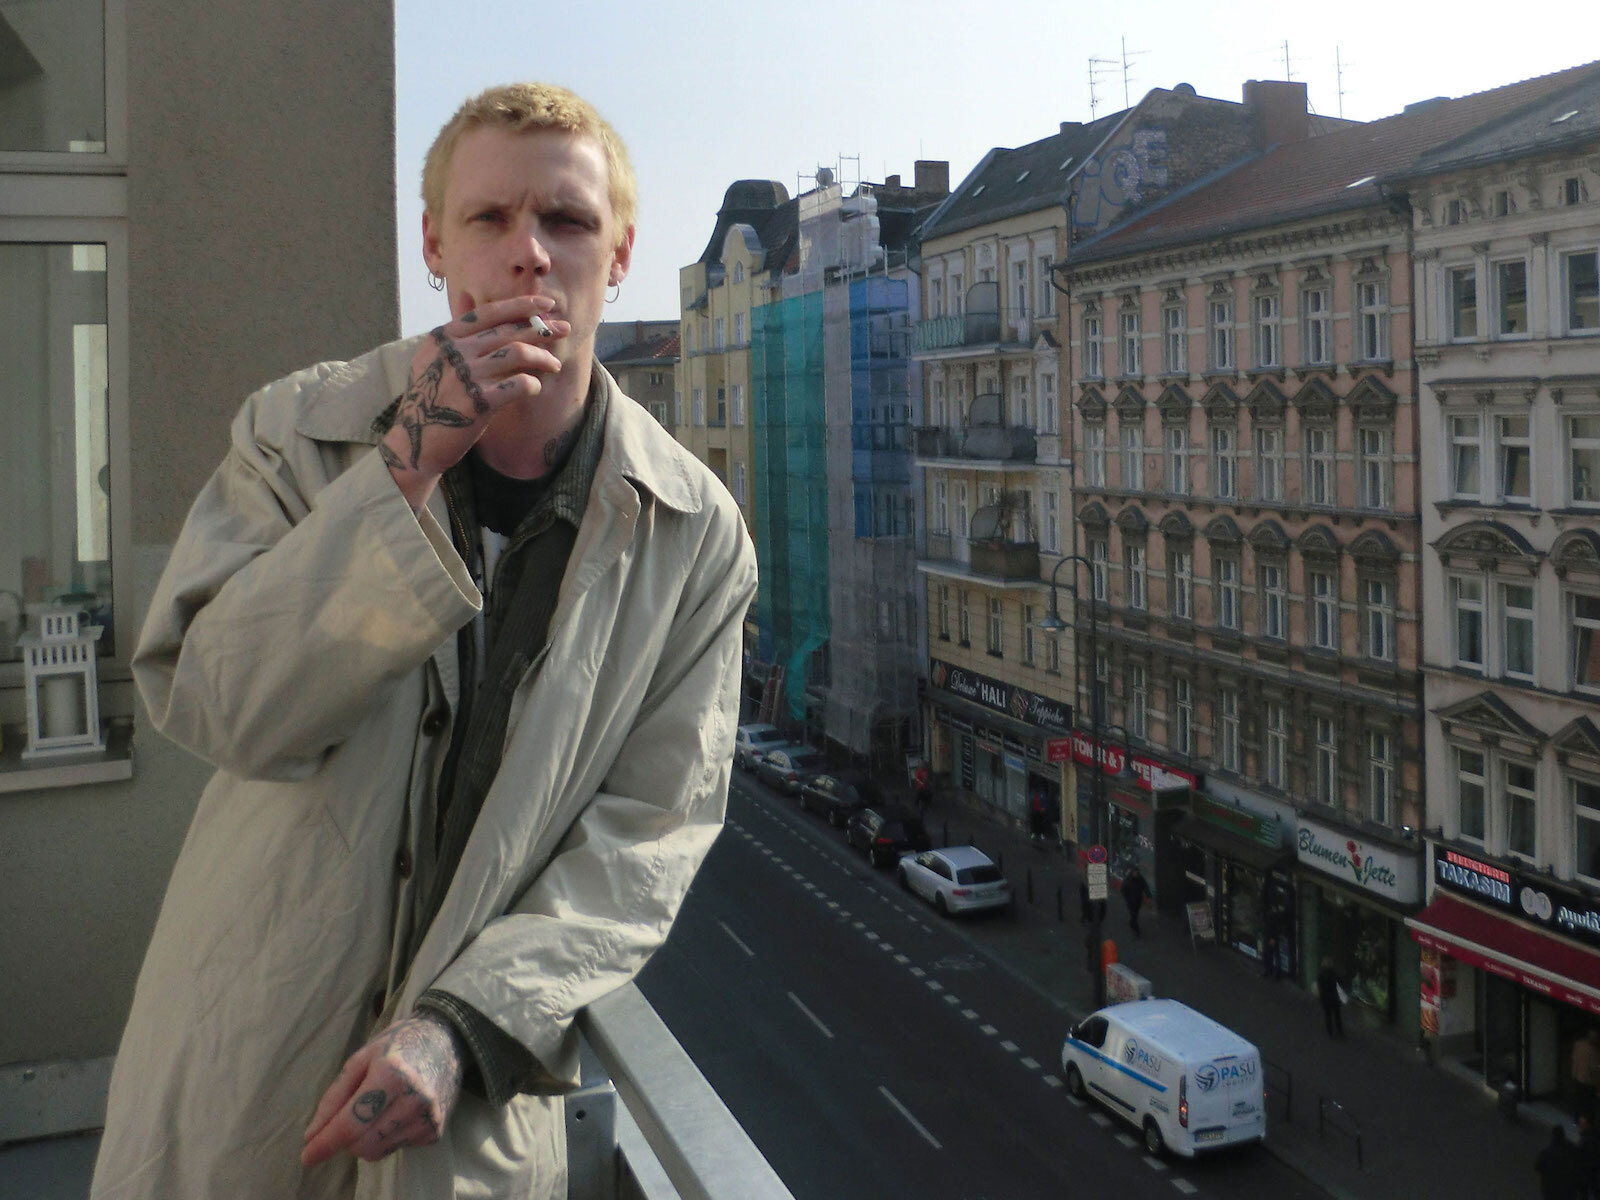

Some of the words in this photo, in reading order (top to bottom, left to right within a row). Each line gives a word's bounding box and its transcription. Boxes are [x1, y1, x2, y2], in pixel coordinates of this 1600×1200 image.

[980, 682, 1005, 708] HALI
[1028, 695, 1064, 727] Teppiche
[1109, 752, 1117, 769] &
[1298, 828, 1348, 868] Blumen
[1362, 855, 1397, 887] Jette
[1437, 858, 1511, 904] TAKASIM
[1136, 1048, 1162, 1073] PASU
[1221, 1061, 1256, 1081] PASU
